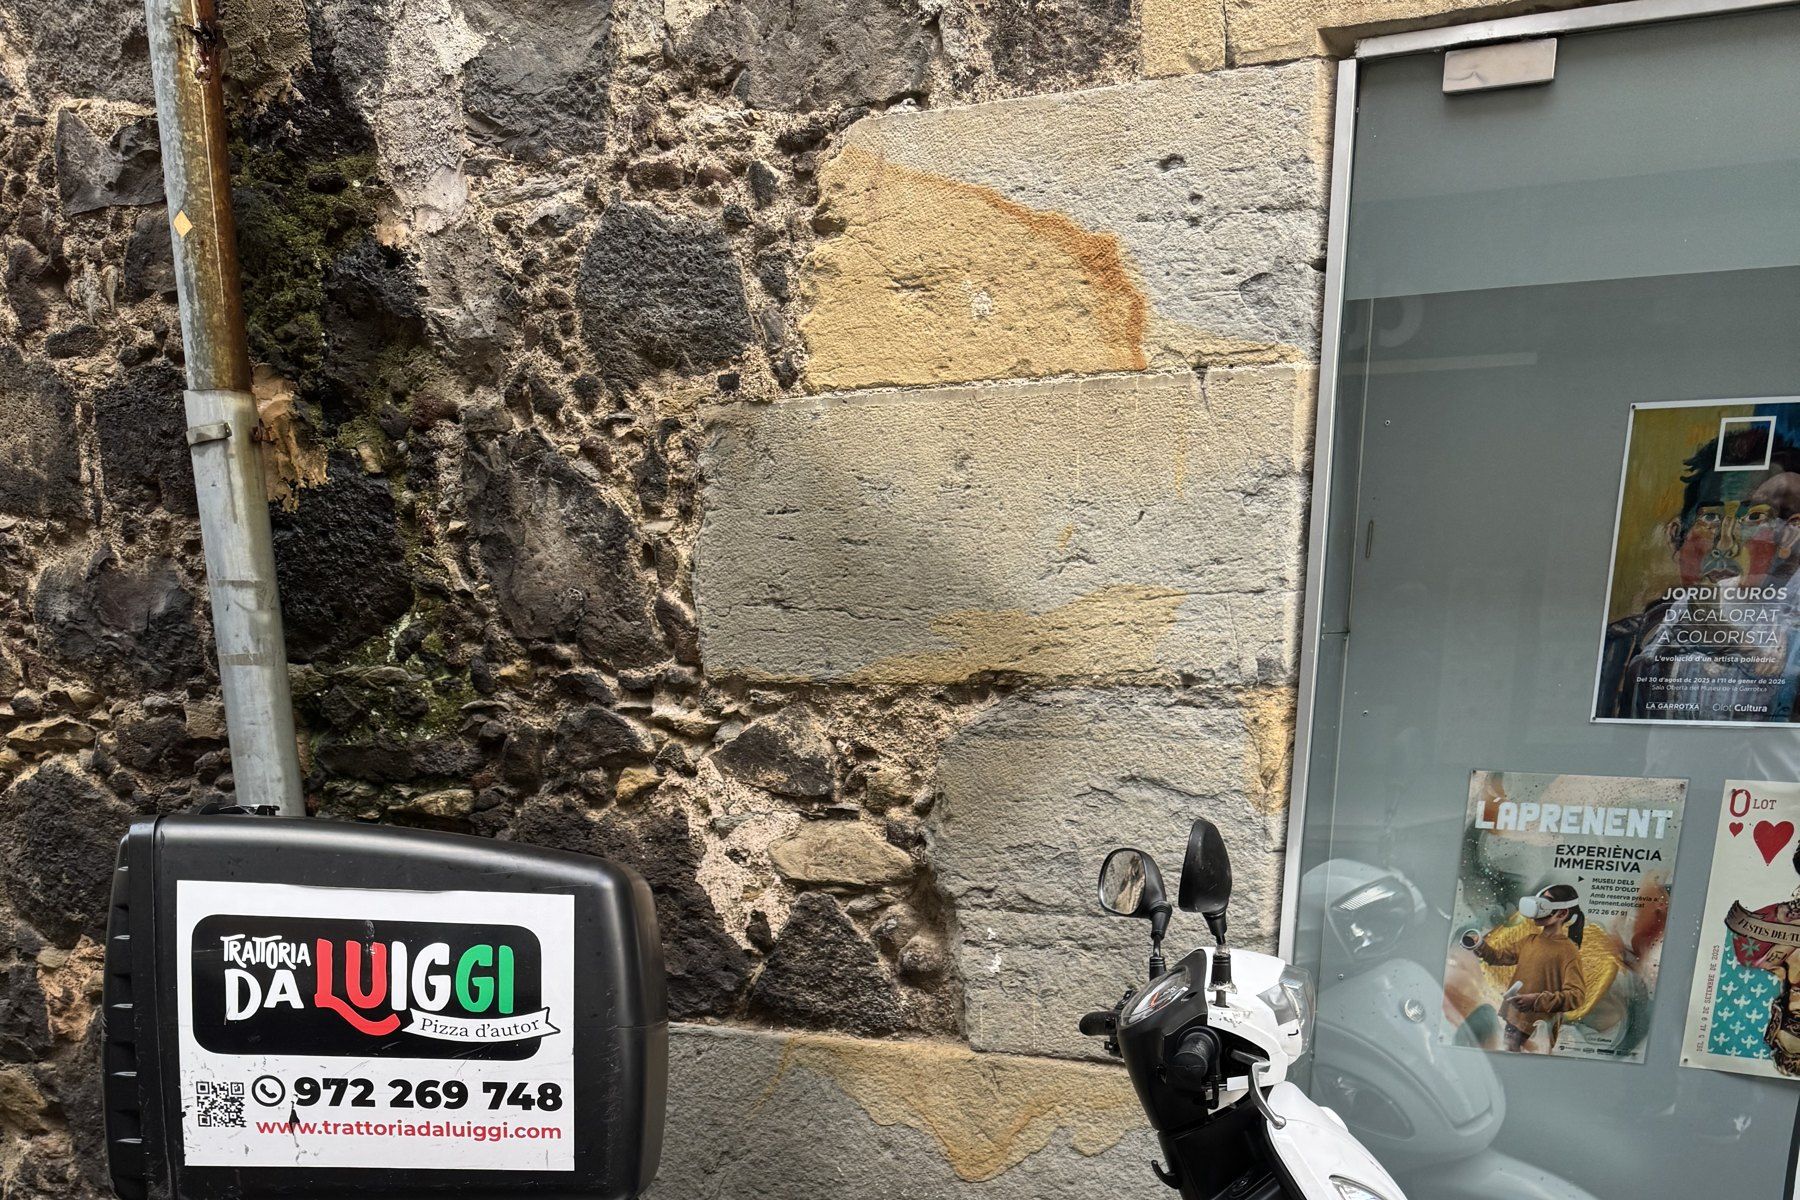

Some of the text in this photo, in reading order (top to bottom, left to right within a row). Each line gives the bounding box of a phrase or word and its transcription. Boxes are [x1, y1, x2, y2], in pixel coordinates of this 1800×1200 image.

[1662, 584, 1788, 600] JORDI CURÓS
[1664, 609, 1781, 622] D'ACALORAT
[1657, 630, 1779, 644] A COLORISTA
[1654, 655, 1693, 663] L'evolució
[1694, 655, 1712, 663] d'un
[1734, 703, 1768, 713] Cultura
[1555, 844, 1662, 861] EXPERIÈNCIA
[1553, 857, 1641, 873] IMMERSIVA
[1592, 877, 1616, 885] MUSEU
[1771, 930, 1788, 940] DEL
[220, 933, 311, 969] TRATTORIA
[224, 938, 514, 1036] DA LUIGGI
[421, 1017, 540, 1039] Pizza d'autor
[293, 1077, 563, 1112] 972 269 748
[255, 1120, 562, 1142] www.trattoriadaluiggi.com
